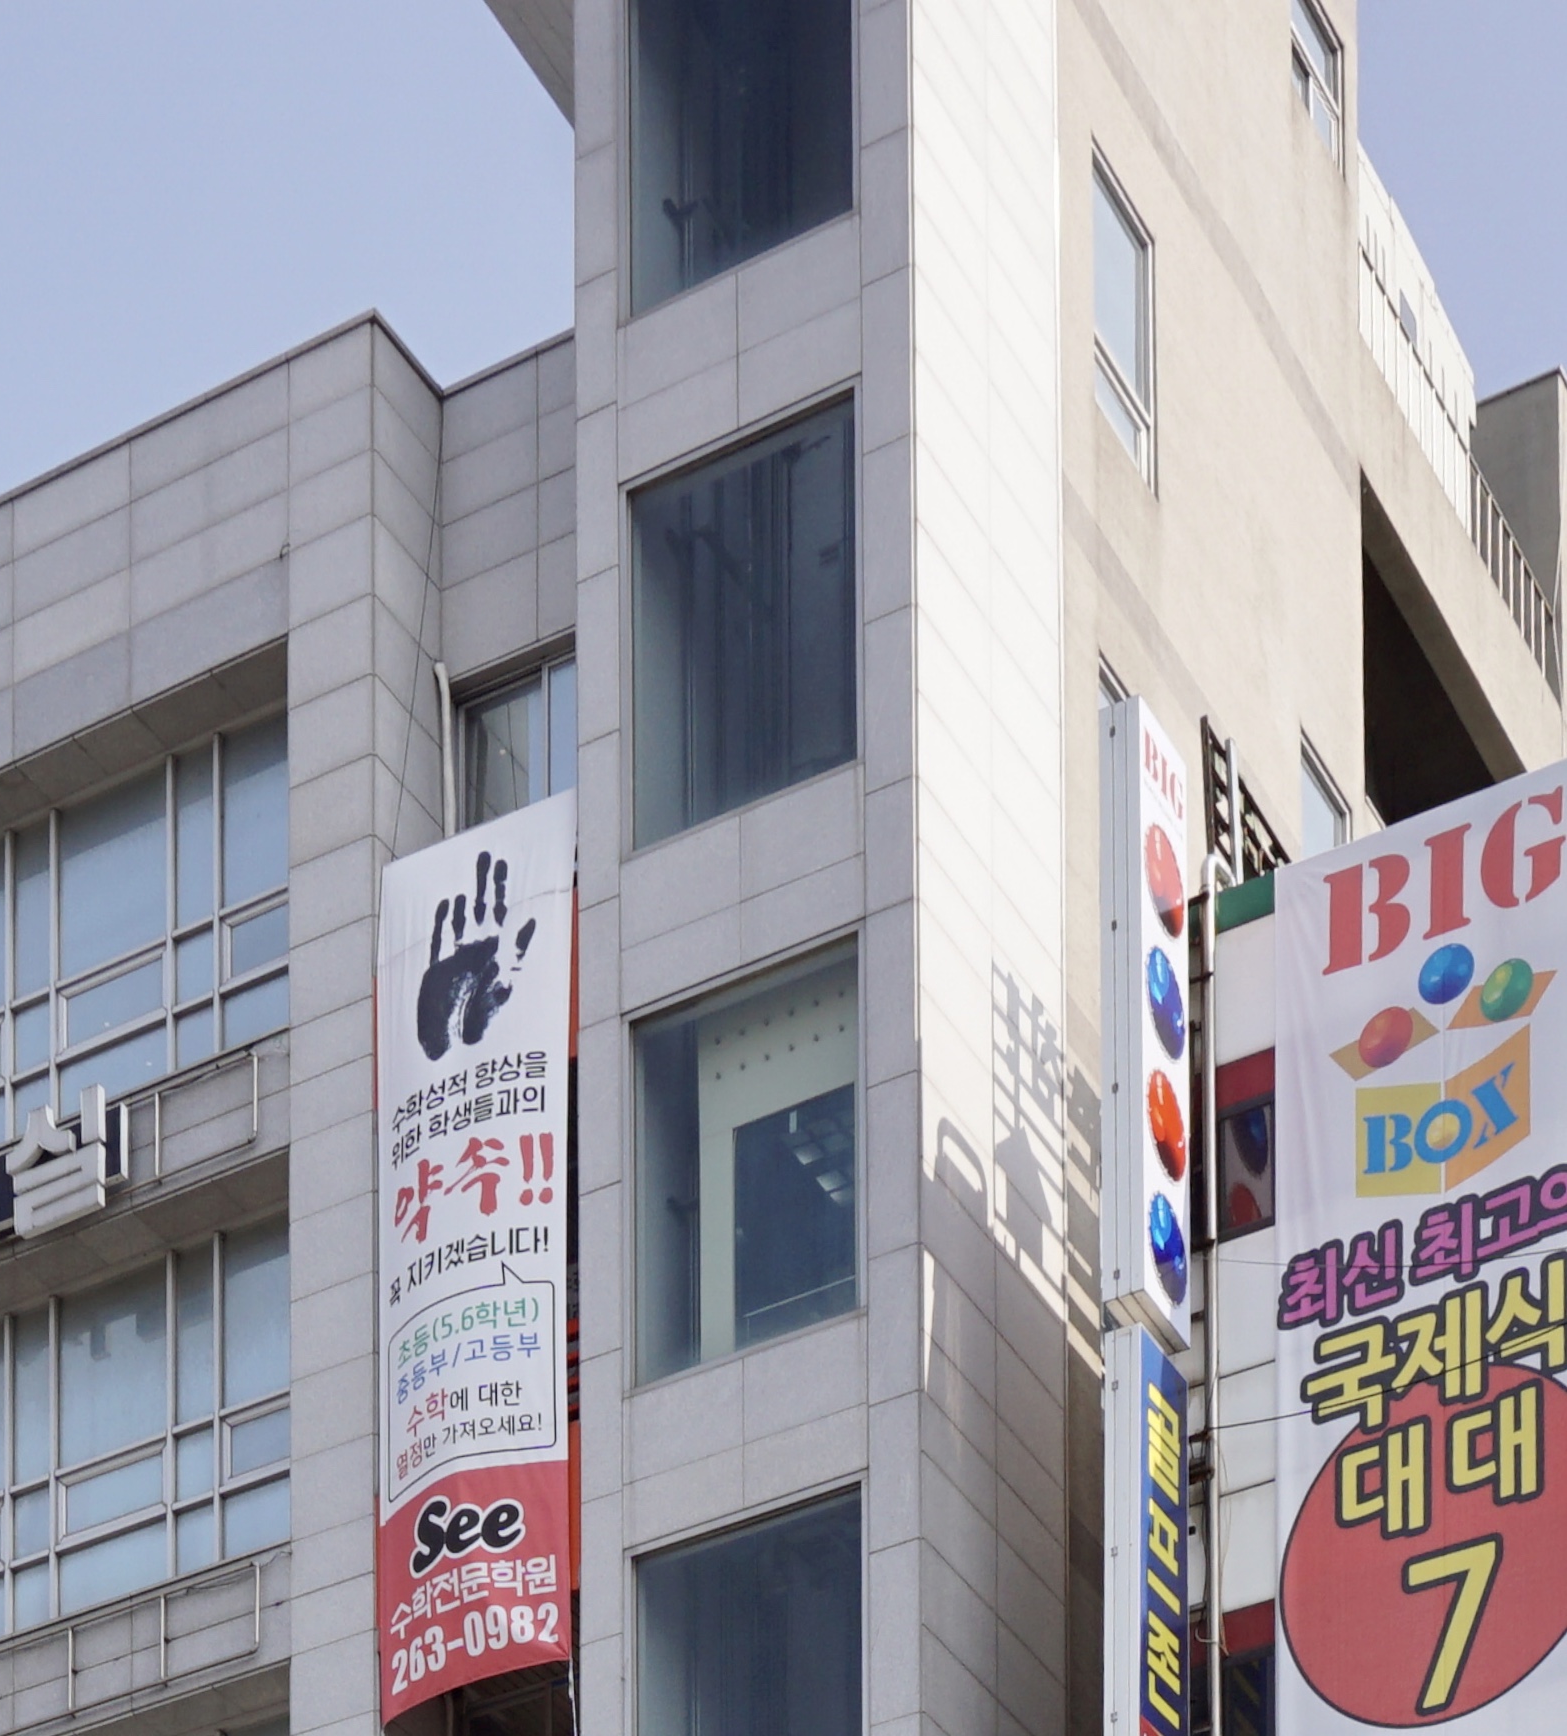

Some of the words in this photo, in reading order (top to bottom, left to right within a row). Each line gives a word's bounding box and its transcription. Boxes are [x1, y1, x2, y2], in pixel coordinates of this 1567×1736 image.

[1144, 726, 1183, 820] BIG
[1322, 785, 1567, 975] BIG
[391, 1124, 422, 1169] 위한
[428, 1085, 545, 1139] 학생들과의
[392, 1070, 467, 1133] 수학성적
[475, 1051, 547, 1089] 향상을
[1363, 1061, 1518, 1175] BOX
[389, 1276, 401, 1307] 꼭
[407, 1226, 548, 1293] 지키겠습니다!
[1281, 1226, 1402, 1325] 최신
[1305, 1257, 1565, 1428] 국제식
[396, 1433, 437, 1480] 열정만
[442, 1413, 542, 1444] 가져오세요!
[406, 1387, 468, 1437] 수학에
[478, 1380, 522, 1407] 대한
[411, 1499, 523, 1575] See
[1147, 1382, 1181, 1730] 골프존
[390, 1554, 557, 1639] 수학전문학원
[1406, 1540, 1497, 1710] 7
[391, 1602, 559, 1696] 263-0982
